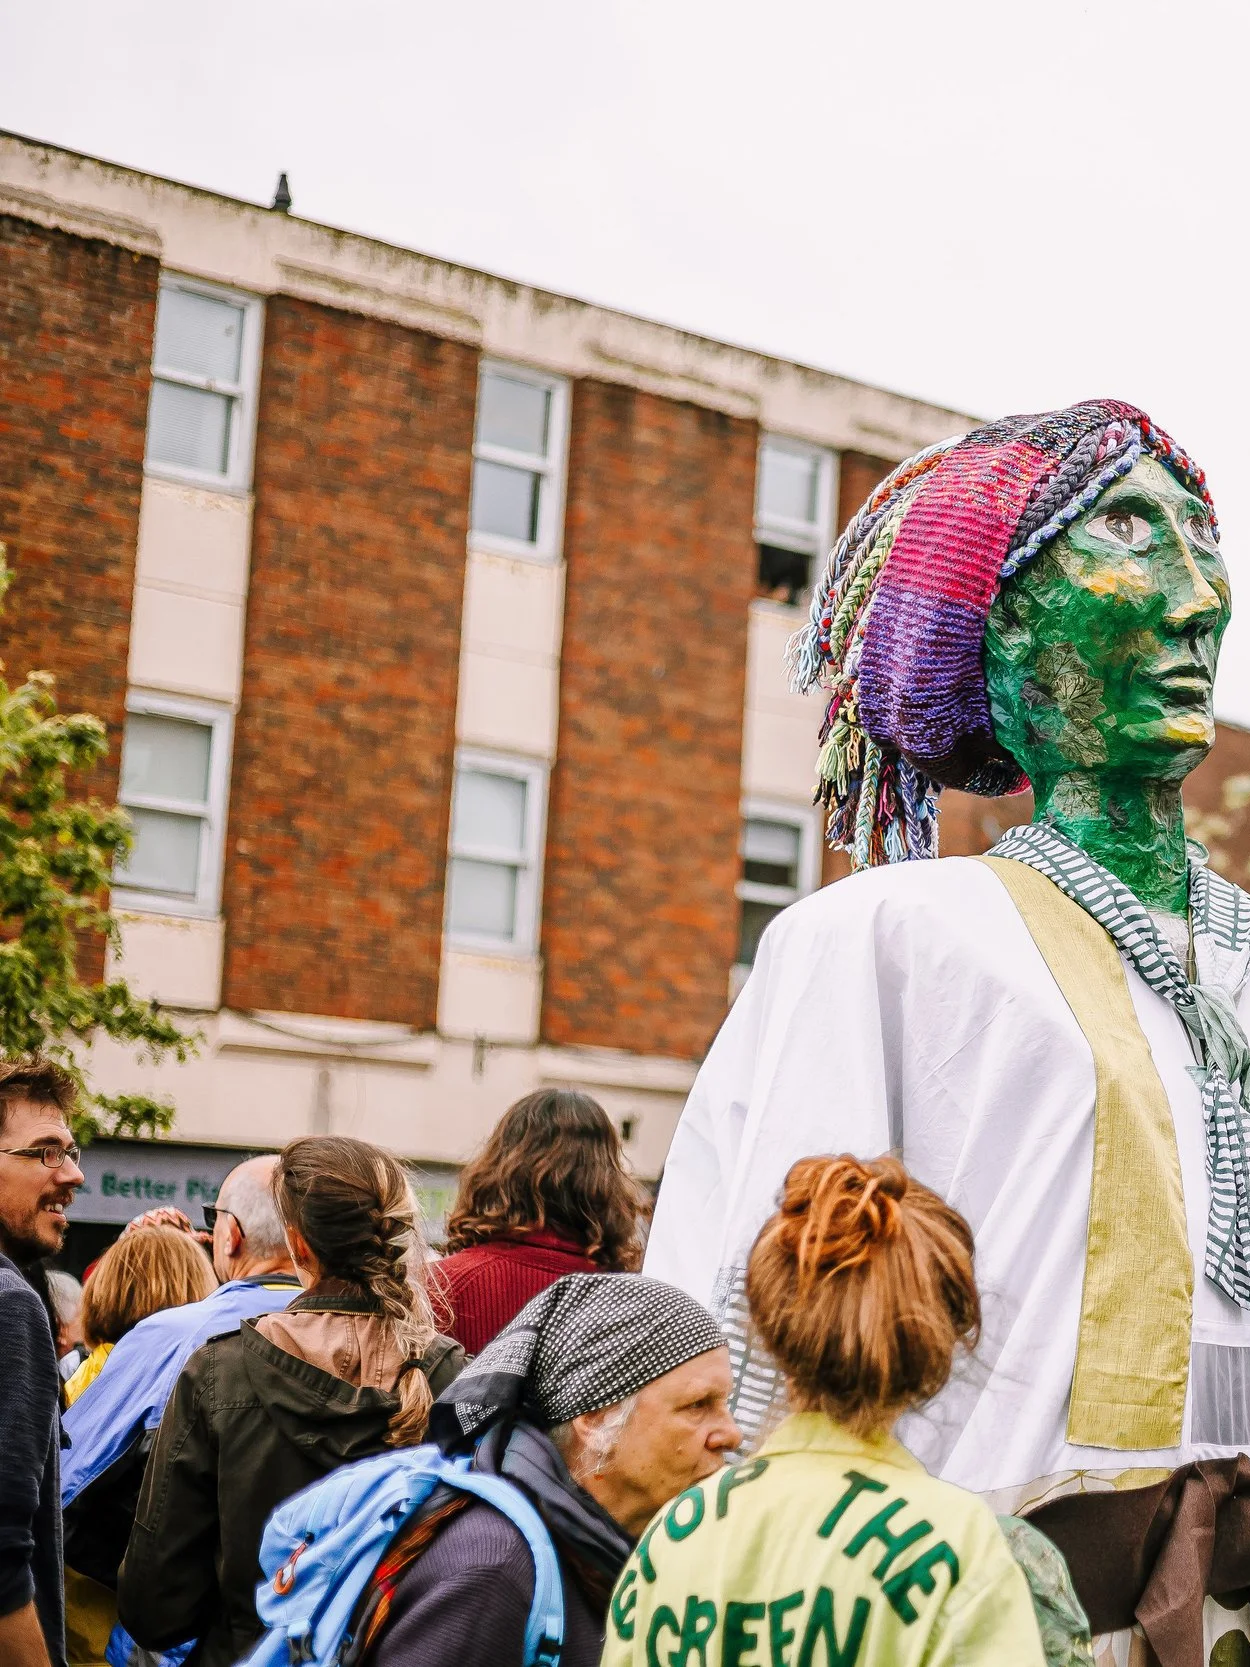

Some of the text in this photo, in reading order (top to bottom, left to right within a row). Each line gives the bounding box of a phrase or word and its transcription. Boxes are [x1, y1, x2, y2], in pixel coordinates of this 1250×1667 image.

[102, 1172, 177, 1199] Better
[816, 1470, 960, 1627] THE
[646, 1585, 872, 1667] GREEN
